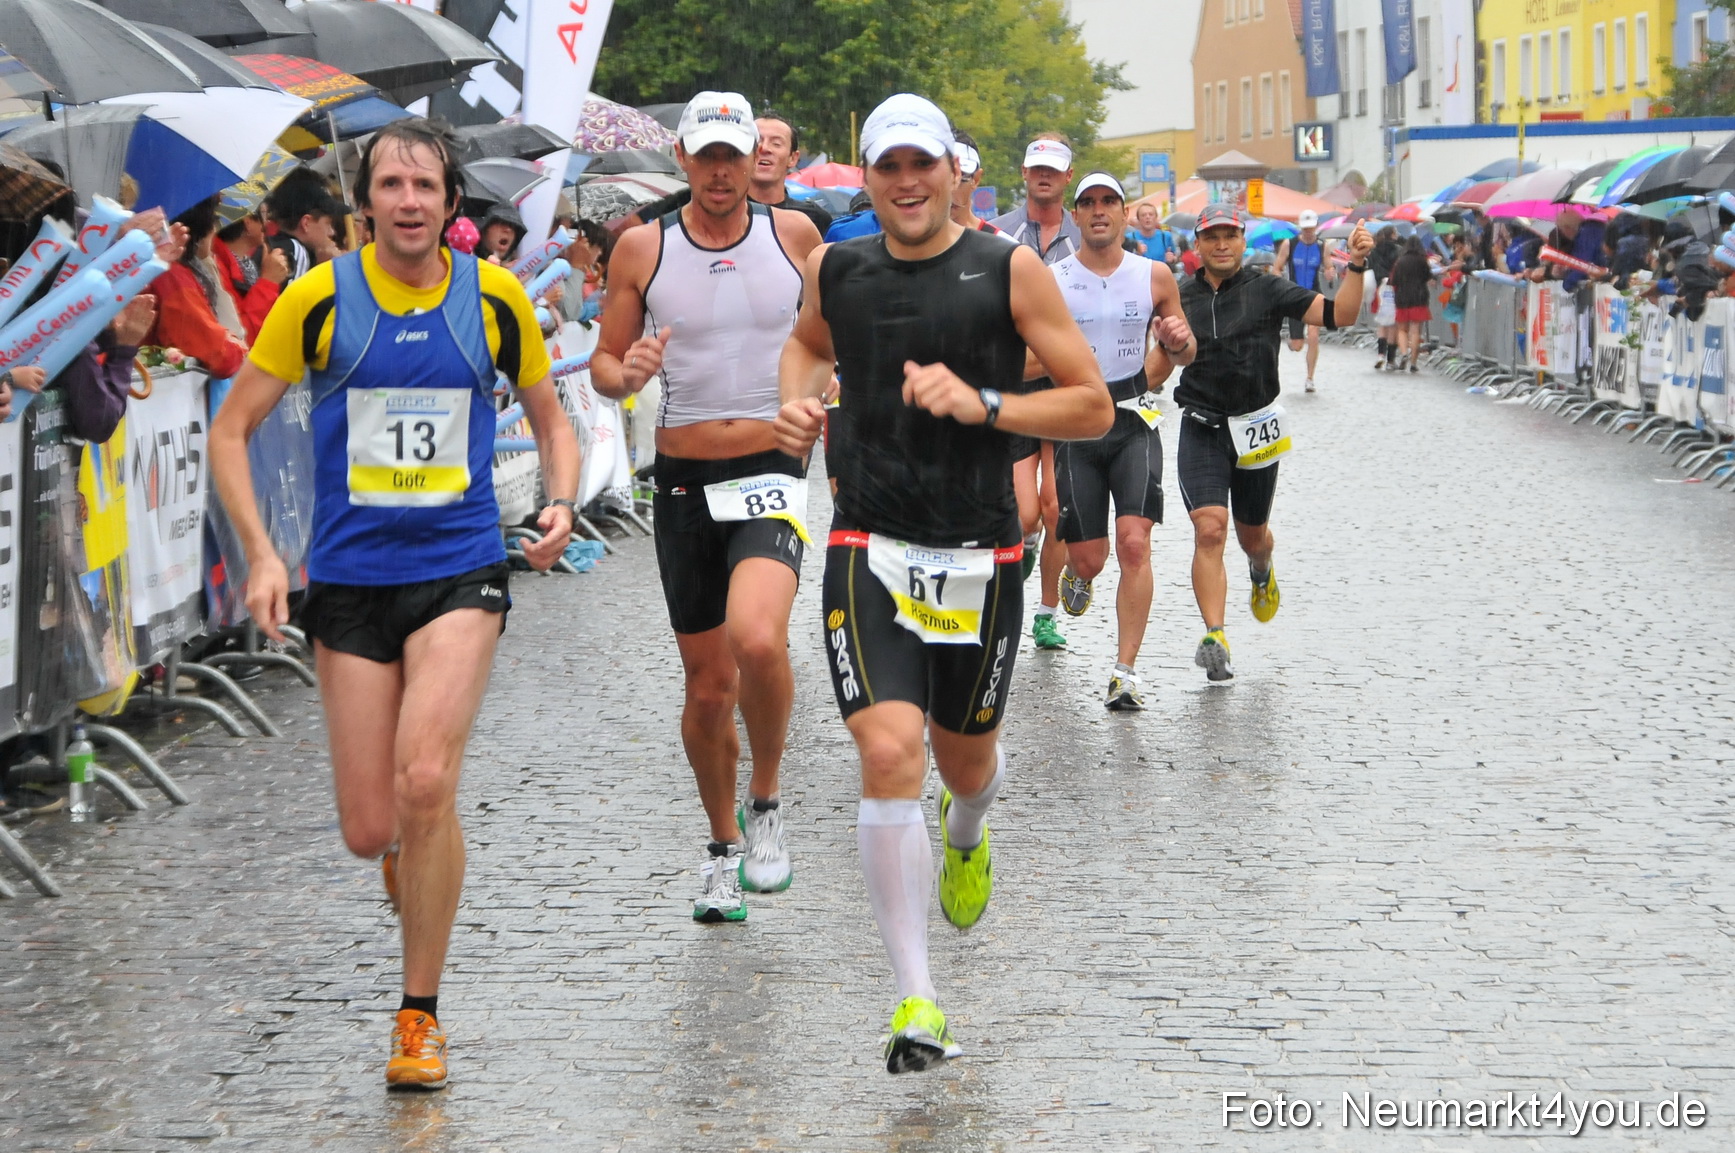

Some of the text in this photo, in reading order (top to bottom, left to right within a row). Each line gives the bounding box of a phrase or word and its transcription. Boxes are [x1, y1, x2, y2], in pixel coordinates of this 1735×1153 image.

[406, 330, 429, 342] asics
[1118, 346, 1142, 358] ITALY
[386, 419, 437, 462] 13
[1245, 418, 1281, 450] 243
[1255, 446, 1278, 462] Robert
[393, 470, 426, 488] Götz
[744, 488, 788, 517] 83
[905, 549, 955, 564] BOCK
[908, 565, 949, 606] 61
[910, 603, 960, 631] Rasmus
[831, 627, 860, 702] SKINS
[982, 636, 1008, 708] SKINS
